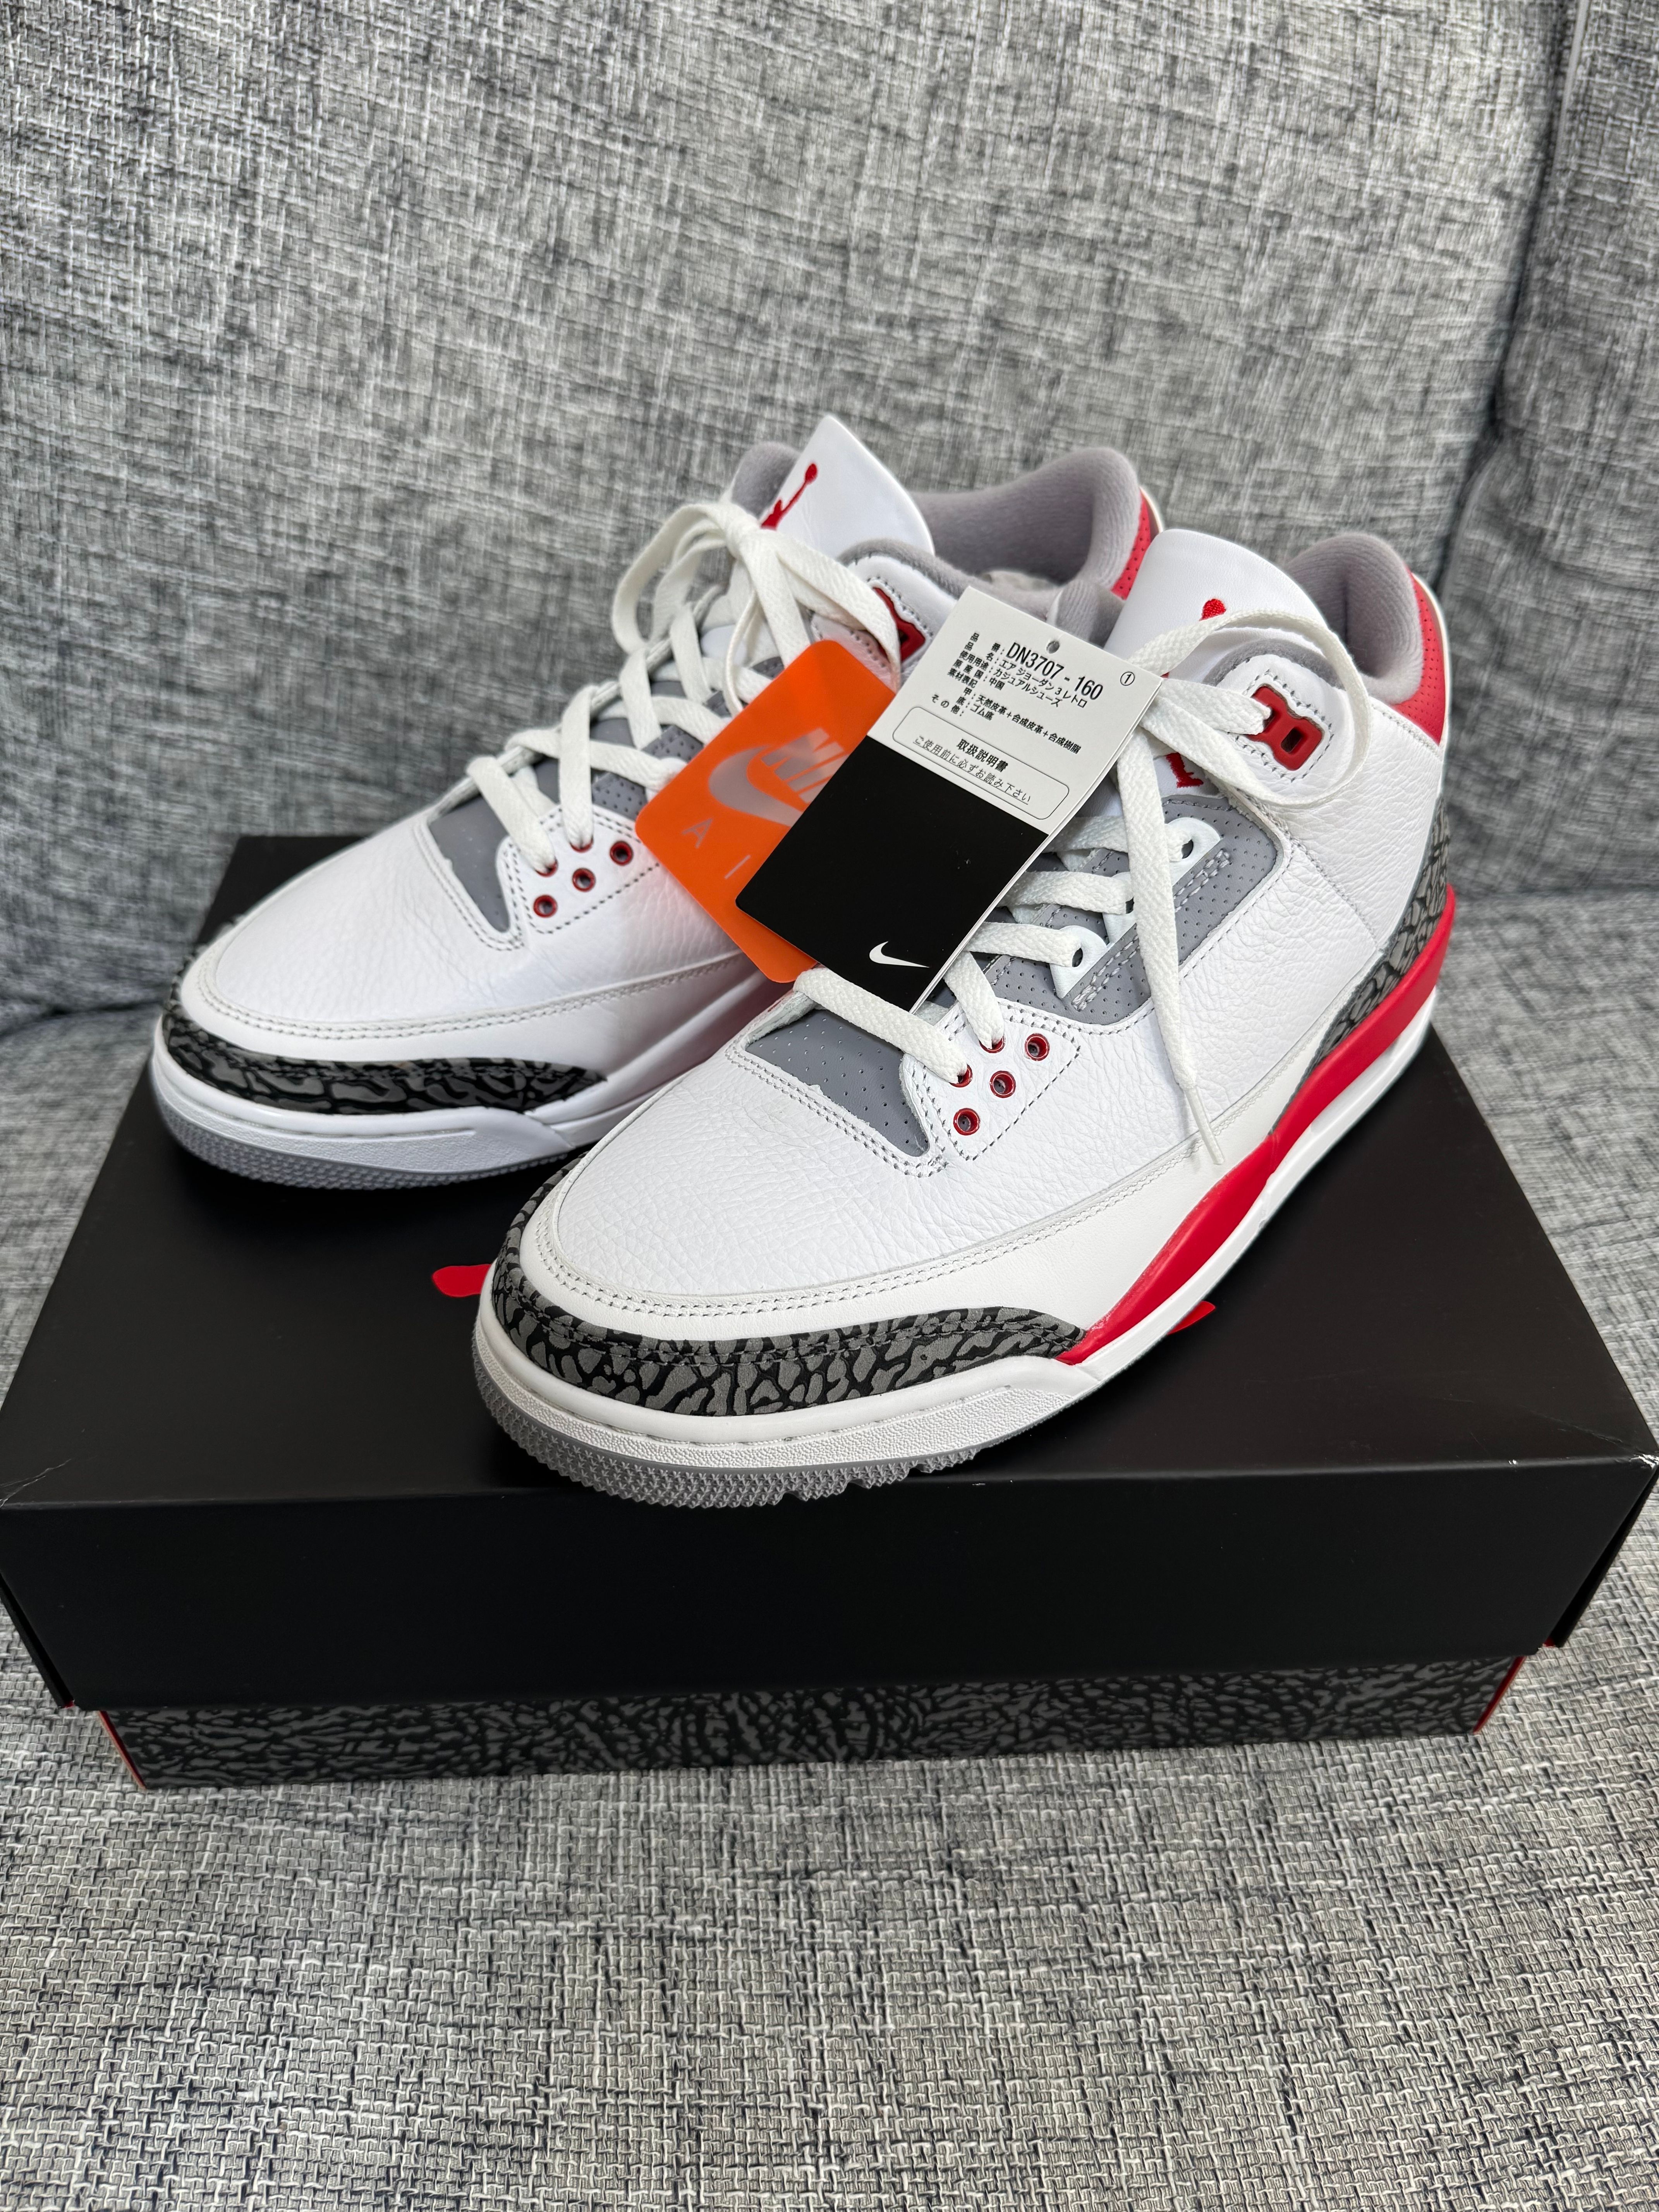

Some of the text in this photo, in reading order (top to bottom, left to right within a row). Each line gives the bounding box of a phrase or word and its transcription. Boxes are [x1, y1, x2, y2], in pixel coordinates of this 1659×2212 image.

[947, 668, 978, 689] 素材表記
[761, 727, 850, 803] NI
[915, 736, 1030, 802] ご使用前に必ずお読み下さい
[956, 738, 1008, 773] 取扱説明書
